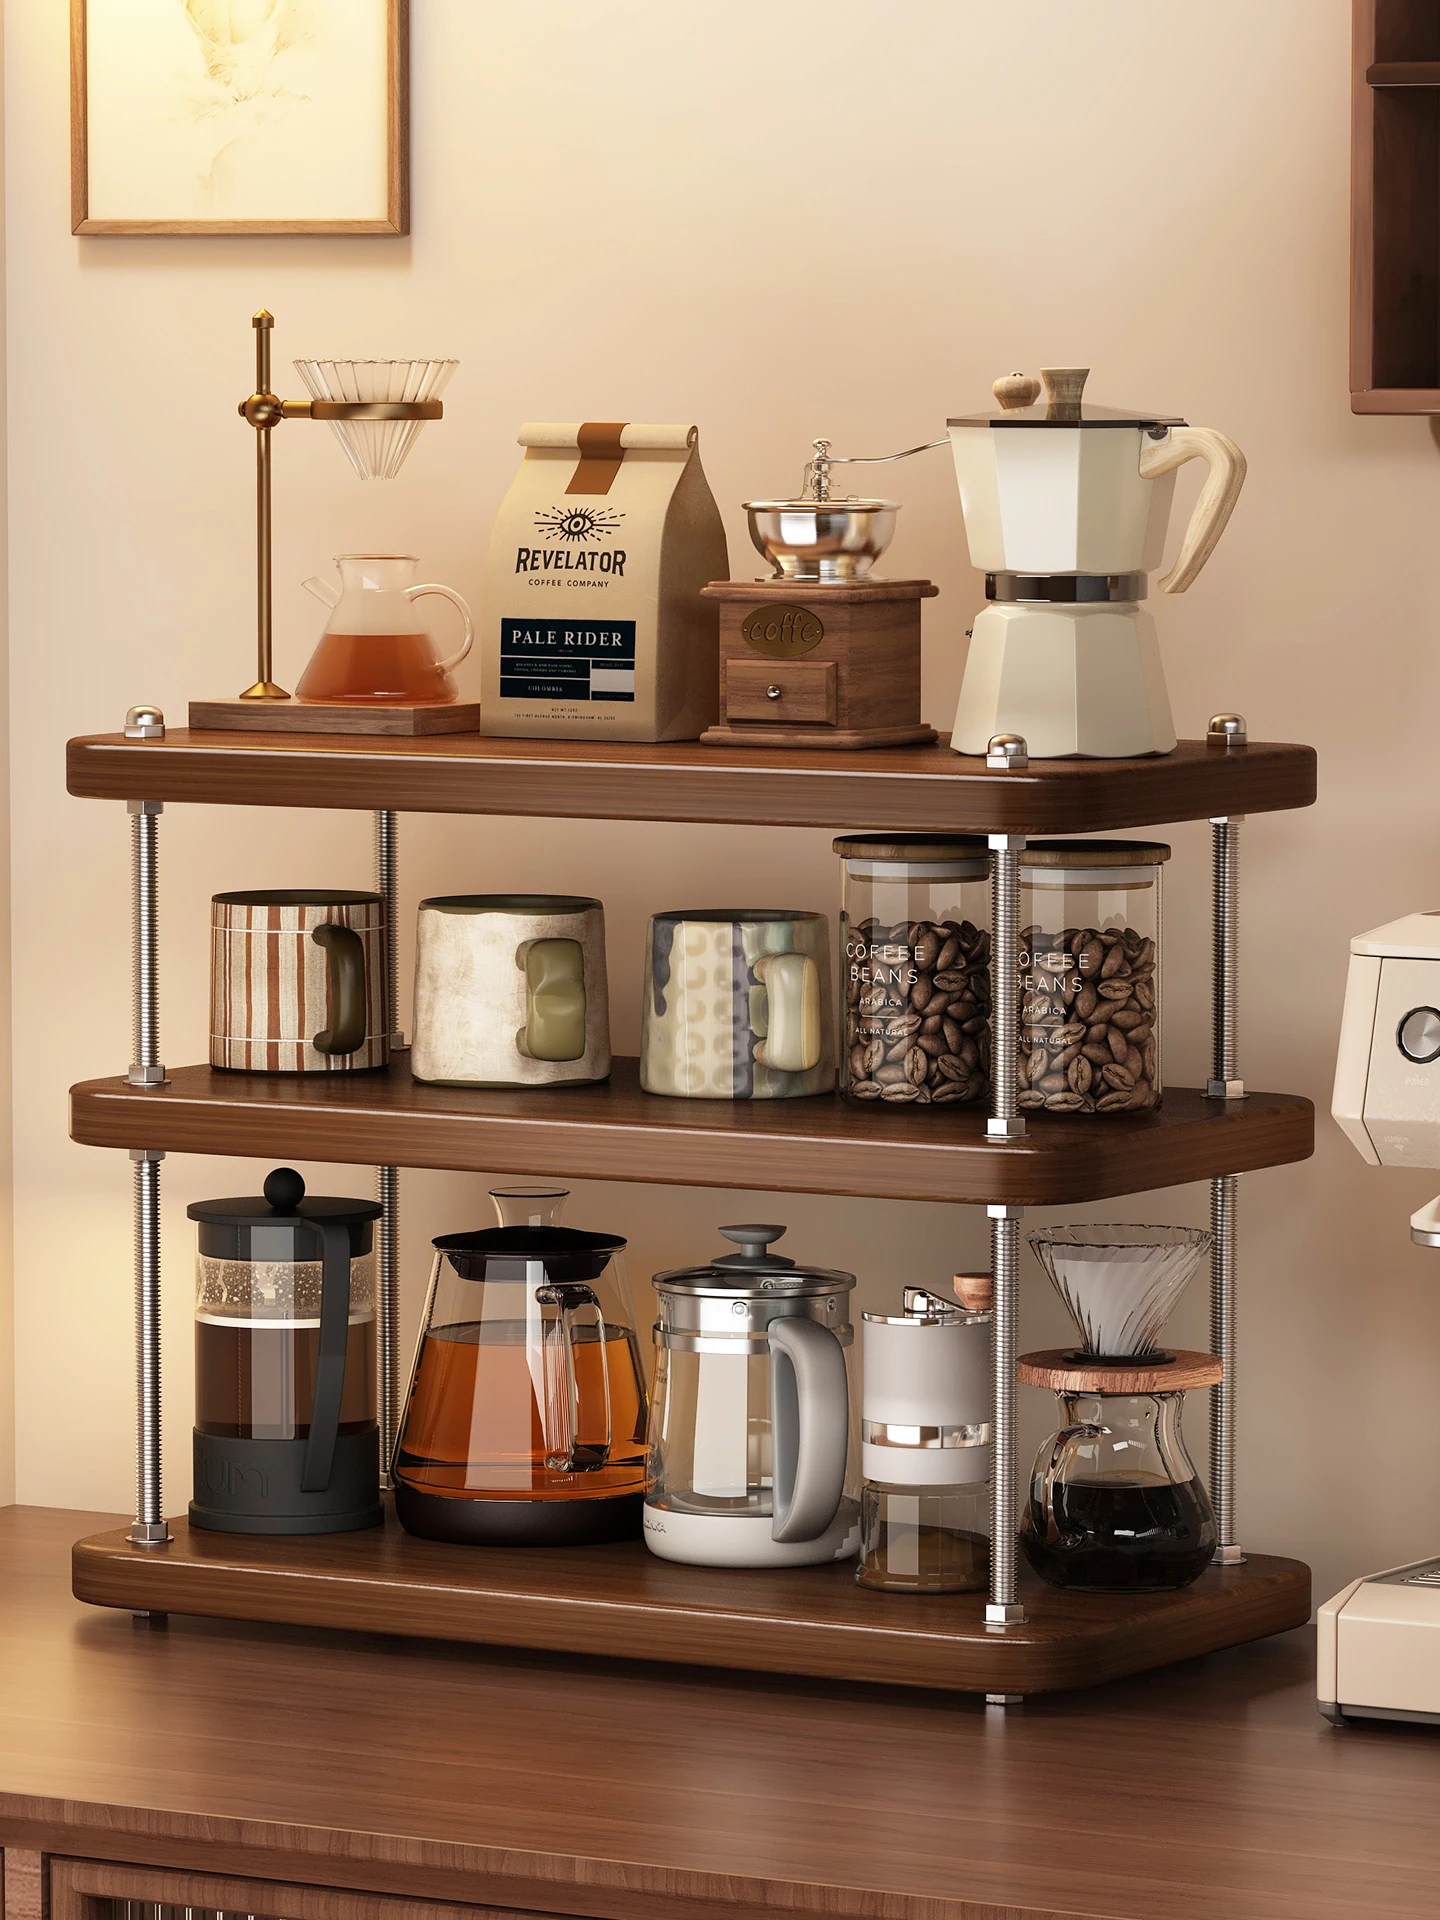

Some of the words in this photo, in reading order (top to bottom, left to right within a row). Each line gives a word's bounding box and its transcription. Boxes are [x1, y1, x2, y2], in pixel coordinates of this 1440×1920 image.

[515, 548, 627, 577] REVELATOR
[528, 578, 562, 587] COFFEE
[567, 580, 610, 588] COMPANY
[749, 612, 814, 642] coffe
[512, 630, 557, 645] PALE
[564, 632, 623, 647] RIDER
[845, 942, 925, 961] COFFEE
[1018, 951, 1090, 969] OFFEE
[850, 966, 919, 984] BEANS
[859, 997, 903, 1007] ARABICA
[1022, 1005, 1067, 1015] ARABICA
[869, 1028, 909, 1036] NATURAL
[1033, 1037, 1073, 1045] NATURAL
[1404, 1076, 1430, 1086] POWER
